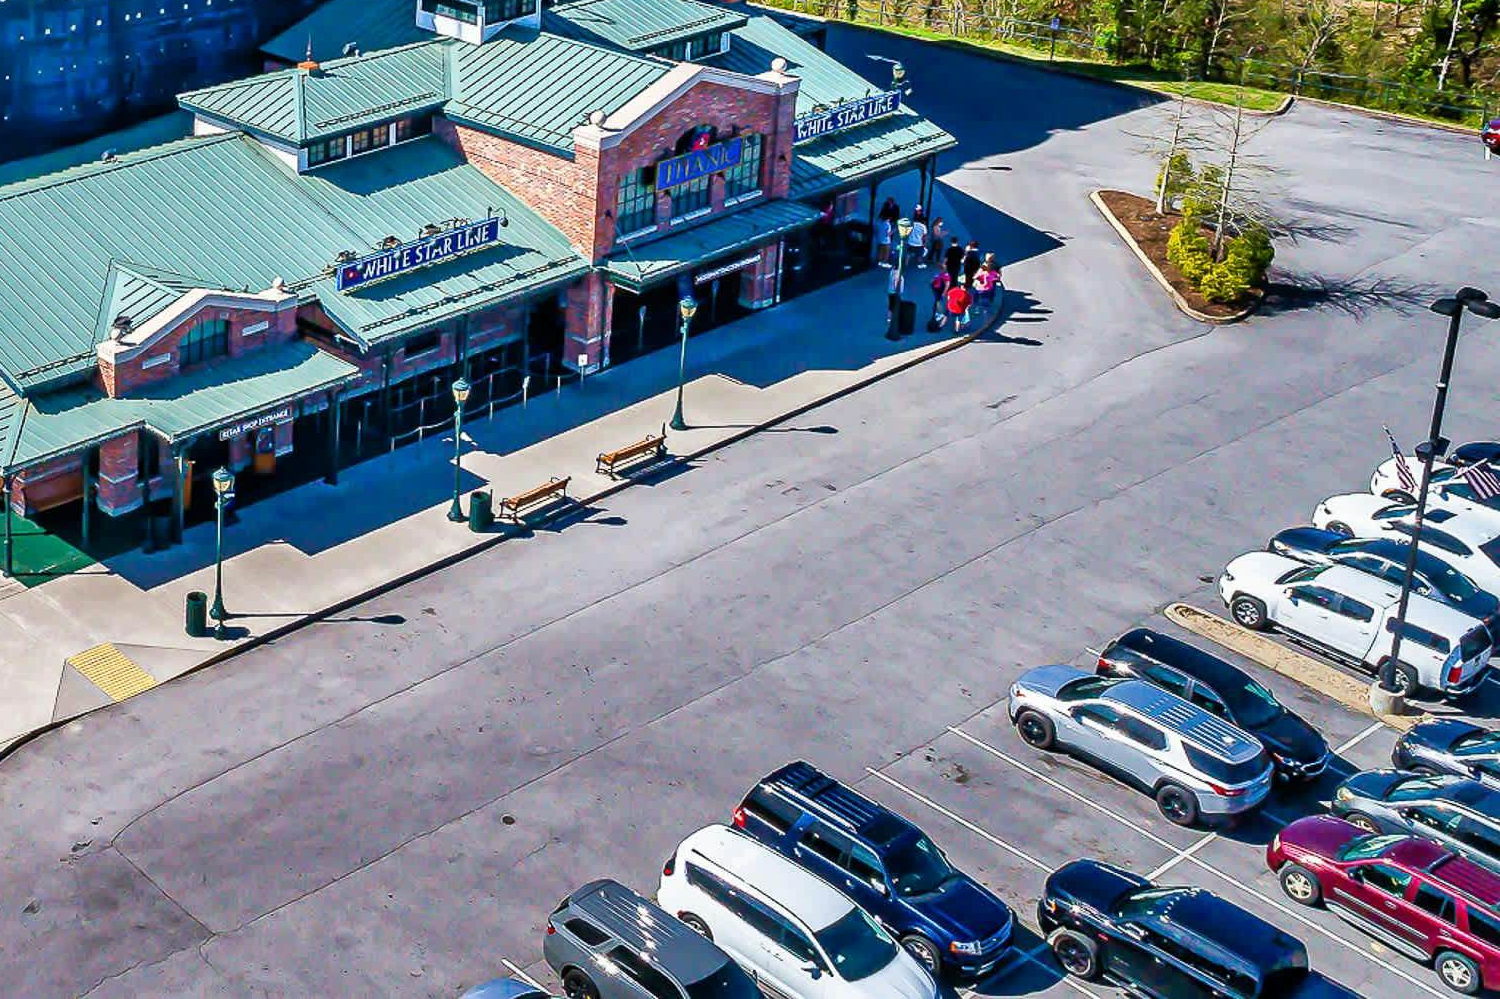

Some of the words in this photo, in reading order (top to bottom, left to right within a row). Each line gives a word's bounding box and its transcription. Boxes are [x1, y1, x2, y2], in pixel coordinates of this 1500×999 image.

[797, 115, 834, 139] WHITE
[837, 106, 866, 127] STAR
[868, 96, 895, 117] LINE
[664, 146, 734, 183] TITANIC
[362, 249, 411, 279] WHITE
[414, 237, 451, 263] STAR
[457, 224, 490, 250] LINE
